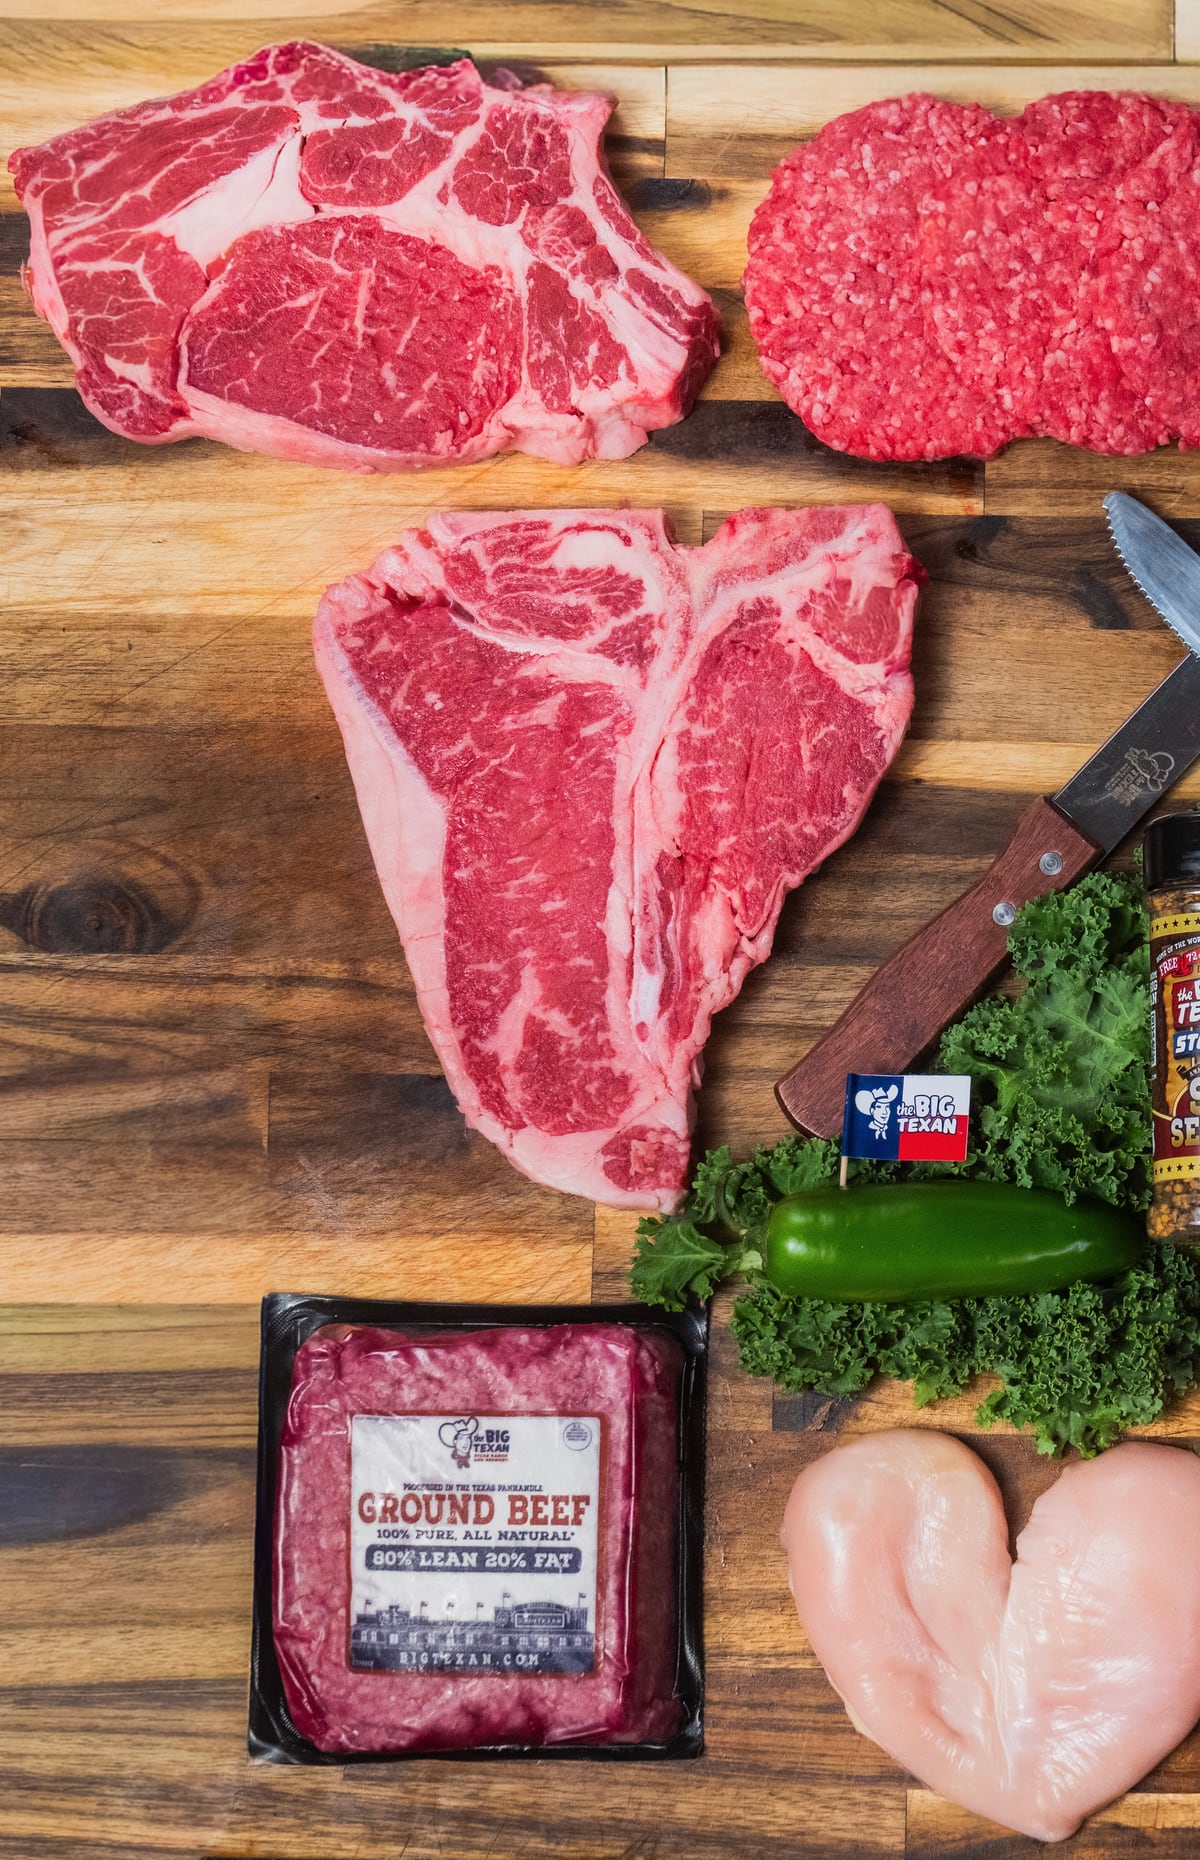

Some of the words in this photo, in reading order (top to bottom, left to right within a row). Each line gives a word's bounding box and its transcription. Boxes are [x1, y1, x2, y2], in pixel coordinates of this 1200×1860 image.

[1174, 940, 1186, 951] THE
[1159, 957, 1178, 976] FREE
[1177, 987, 1193, 1002] the
[896, 1101, 914, 1117] the
[914, 1095, 955, 1118] BIG
[897, 1117, 957, 1135] TEXAN
[485, 1429, 510, 1443] BIG
[473, 1443, 510, 1453] TEXAN
[444, 1483, 454, 1492] IN
[456, 1483, 470, 1492] THE
[472, 1484, 496, 1493] TEXAS
[497, 1484, 543, 1493] PANHANDLE
[357, 1492, 495, 1526] GROUND
[508, 1494, 591, 1526] BEEF
[377, 1529, 410, 1540] 100%
[416, 1530, 457, 1541] PURE,
[463, 1531, 492, 1541] ALL
[372, 1550, 413, 1567] 80%
[420, 1552, 478, 1568] LEAN
[485, 1552, 527, 1568] 20%
[533, 1553, 573, 1568] FAT
[399, 1651, 540, 1666] BIGTEXAN.COM
